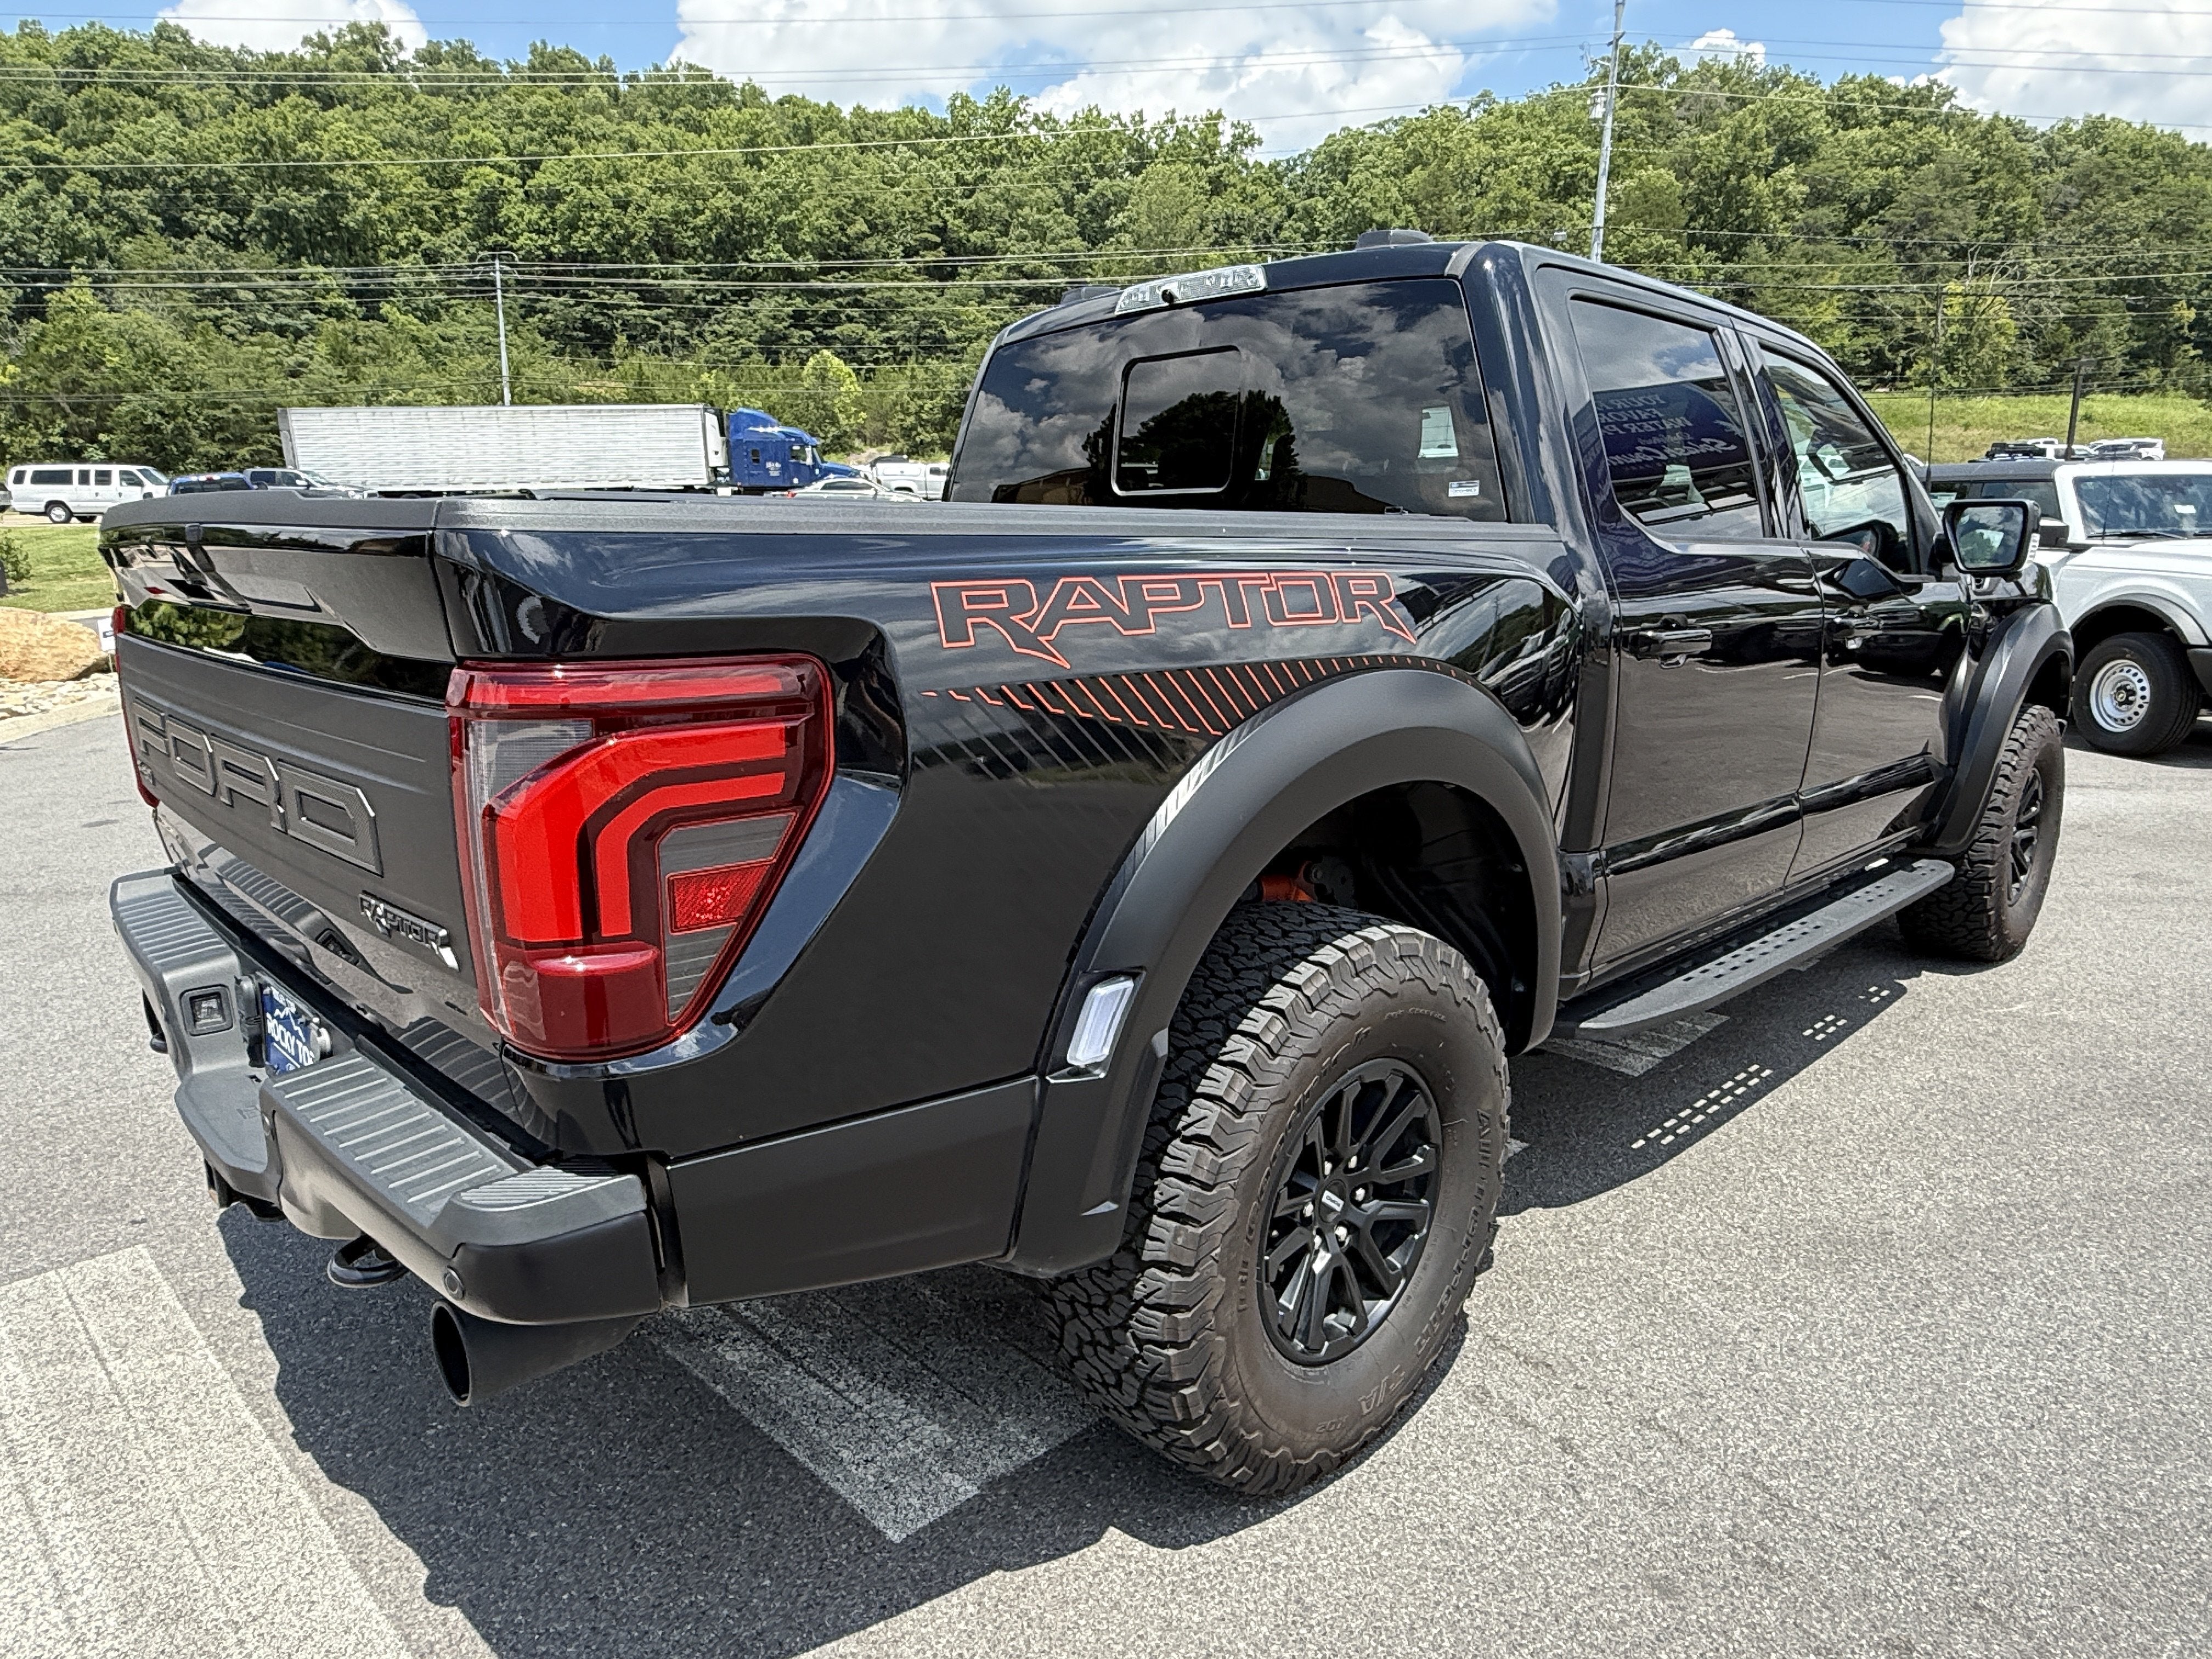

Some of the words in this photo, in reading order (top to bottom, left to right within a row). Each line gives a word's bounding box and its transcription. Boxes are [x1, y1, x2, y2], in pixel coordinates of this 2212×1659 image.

[930, 571, 1417, 669] RAPTOR
[133, 697, 383, 878] FORD
[358, 890, 462, 973] RAPTOR
[266, 1012, 295, 1056] ROCKY
